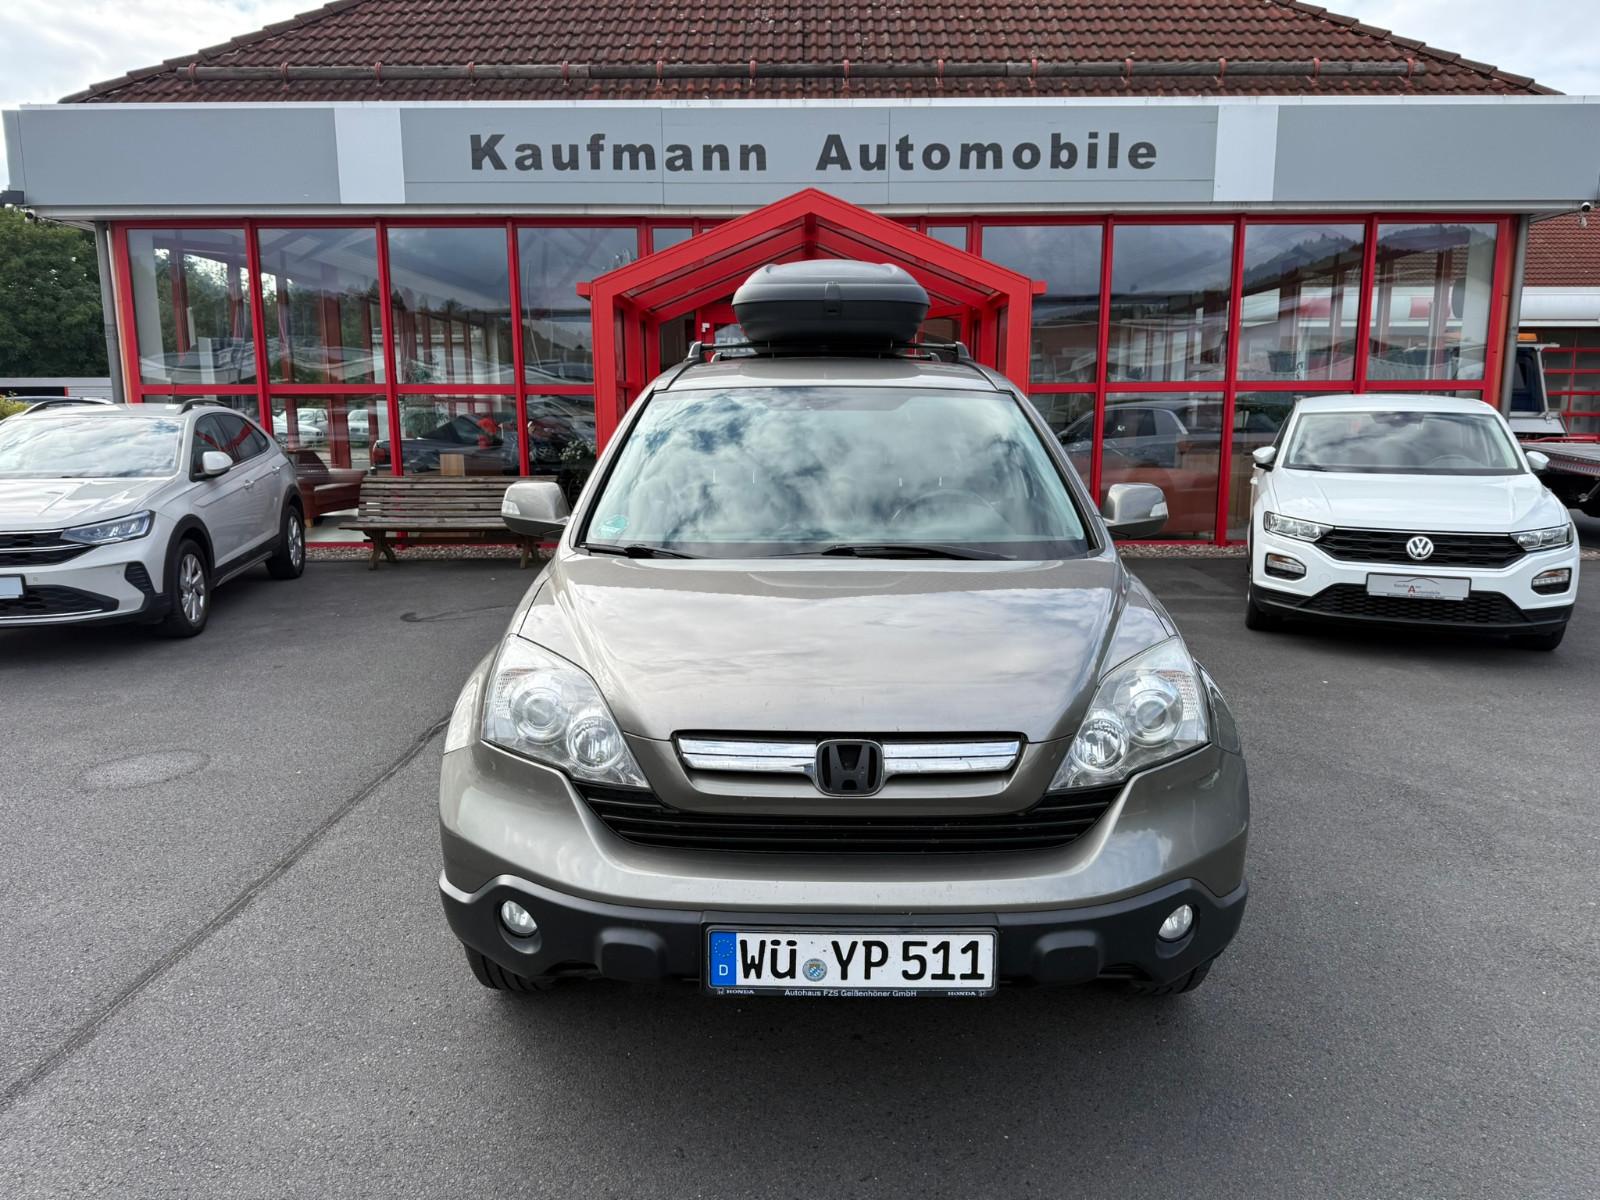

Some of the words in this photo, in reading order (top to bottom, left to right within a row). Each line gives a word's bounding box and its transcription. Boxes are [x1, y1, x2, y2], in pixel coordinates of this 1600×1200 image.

[469, 133, 767, 171] Kaufmann
[815, 131, 1157, 171] Automobile
[718, 964, 729, 976] D
[740, 939, 797, 980] WÜ
[831, 940, 889, 980] YP
[901, 940, 985, 980] 511
[784, 989, 821, 997] Autohaus
[892, 989, 917, 997] GmbH
